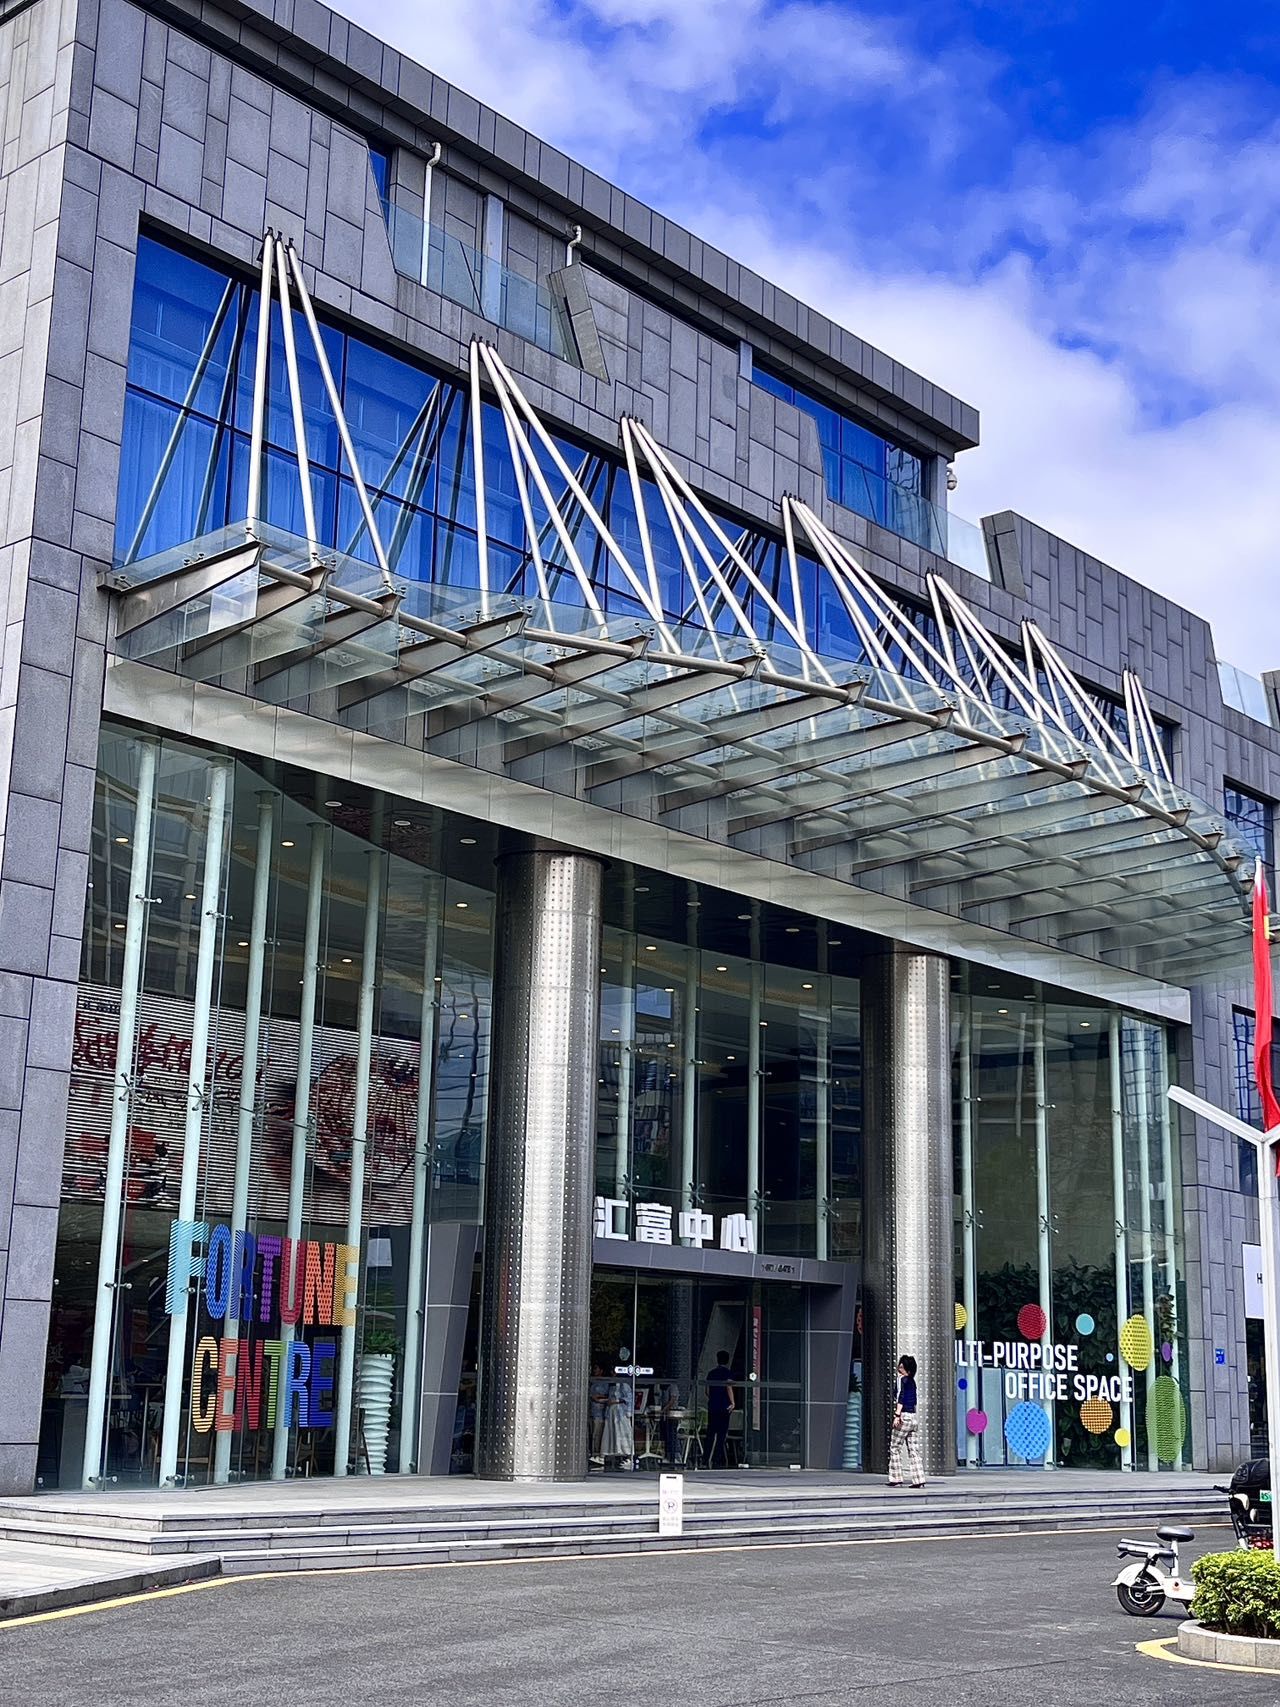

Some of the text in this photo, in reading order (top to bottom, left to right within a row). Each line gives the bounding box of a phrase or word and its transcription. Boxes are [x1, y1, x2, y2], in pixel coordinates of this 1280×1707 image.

[595, 1196, 754, 1253] 汇富中心
[164, 1219, 359, 1328] FORTUNE
[192, 1336, 335, 1432] CENTRE
[955, 1340, 1079, 1371] LTI-PURPOSE
[1005, 1373, 1133, 1403] OFFICE SPACE
